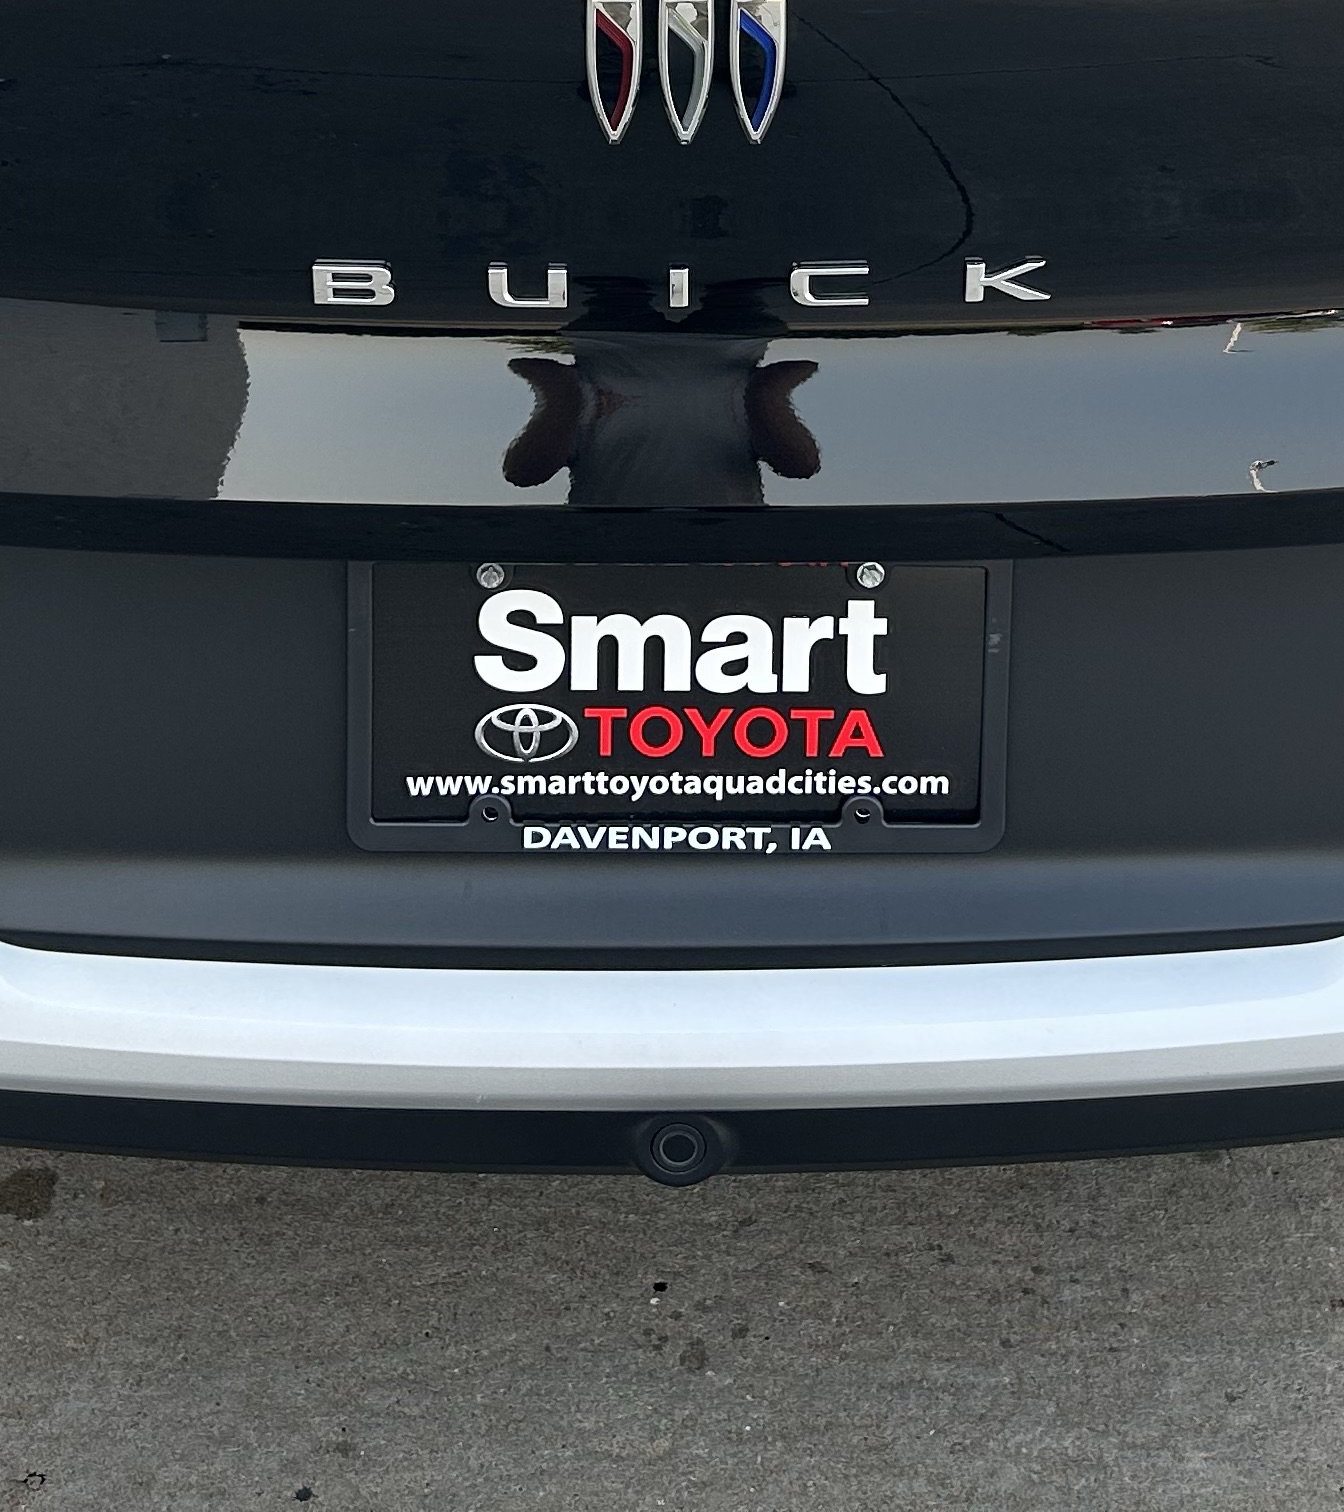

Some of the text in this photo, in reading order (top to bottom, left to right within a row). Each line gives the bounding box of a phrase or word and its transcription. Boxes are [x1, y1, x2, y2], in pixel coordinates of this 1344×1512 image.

[311, 256, 1053, 308] BUICK
[473, 589, 888, 695] Smart
[584, 705, 885, 758] TOYOTA
[406, 768, 950, 799] www.smarttoyotaquadcities.com
[522, 826, 832, 854] DAVENPORT, IA
